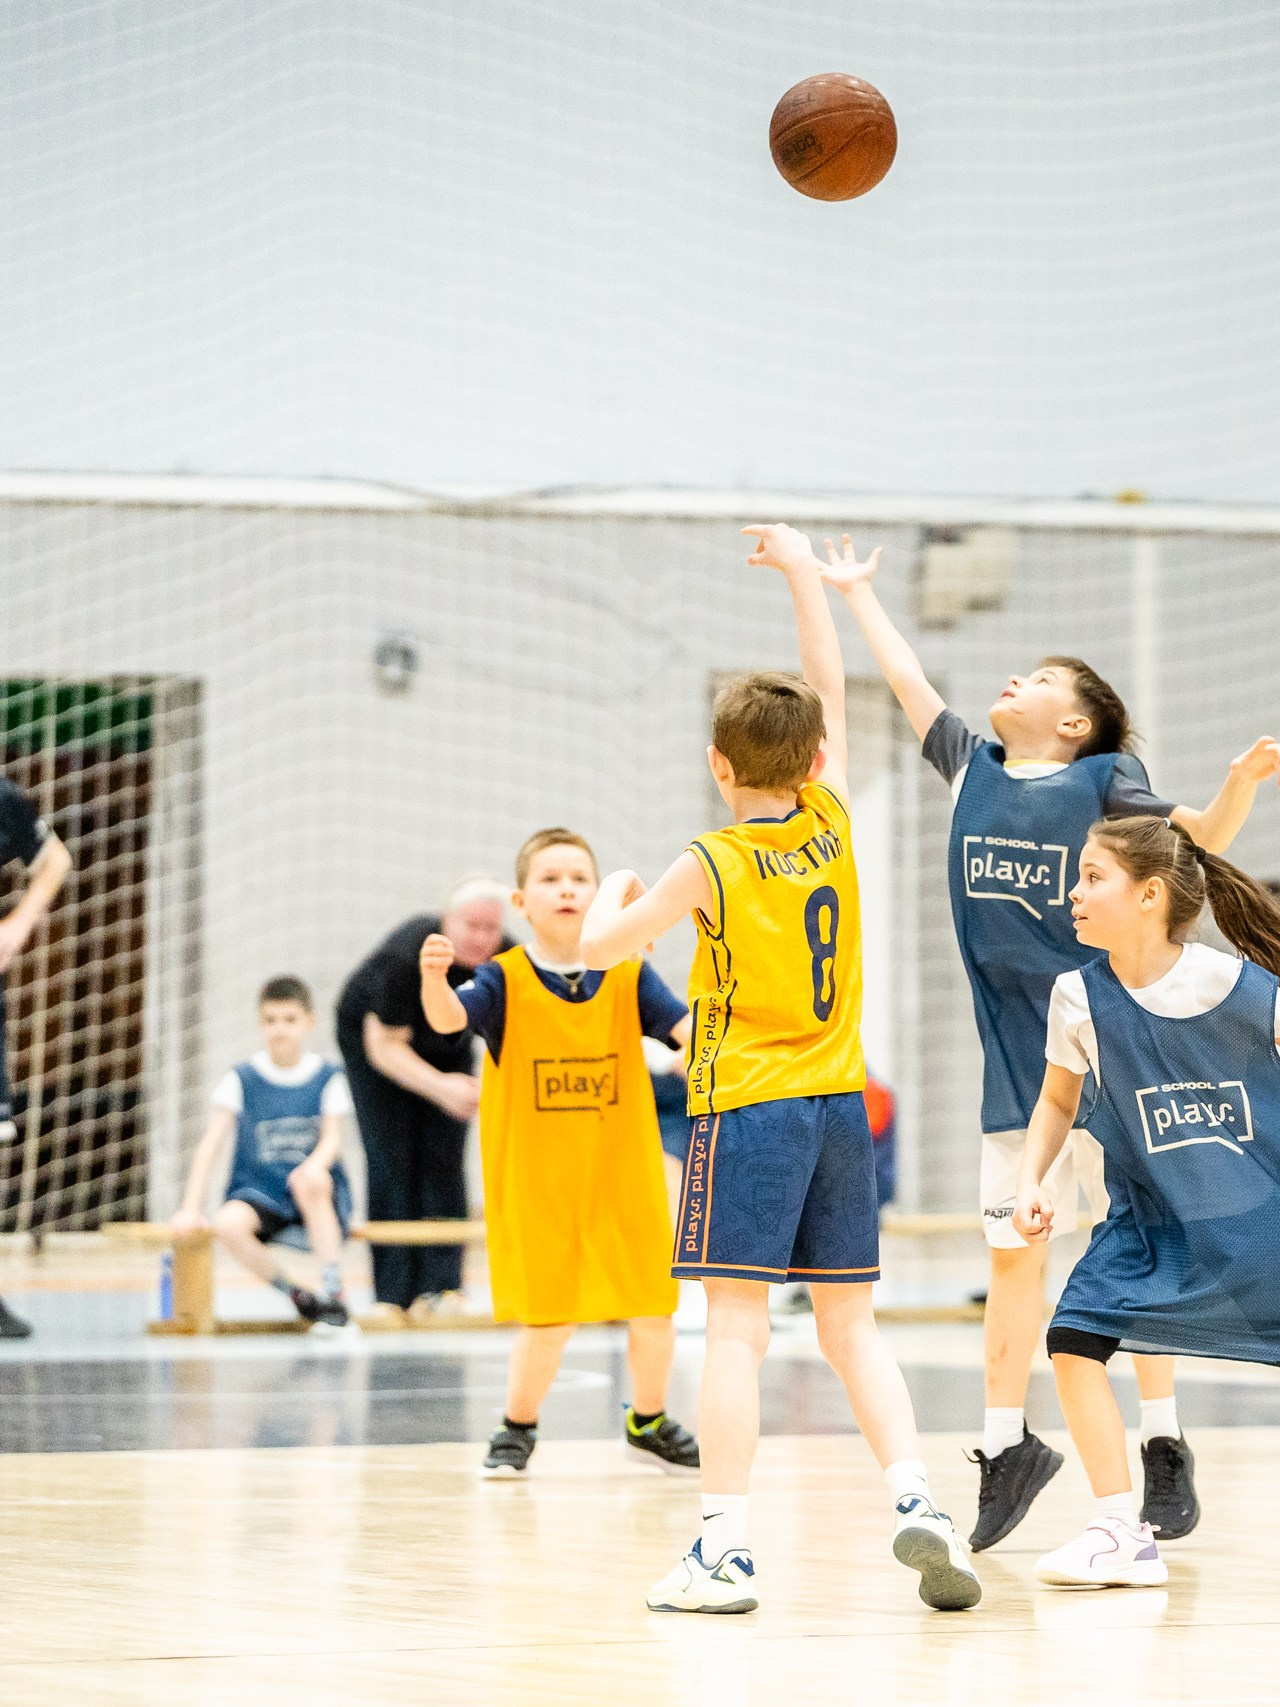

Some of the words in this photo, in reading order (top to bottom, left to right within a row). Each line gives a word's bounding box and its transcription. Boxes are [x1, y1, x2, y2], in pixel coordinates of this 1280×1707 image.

[985, 837, 1039, 850] SCHOOL
[804, 885, 839, 1022] 8
[1161, 1082, 1216, 1092] SCHOOL
